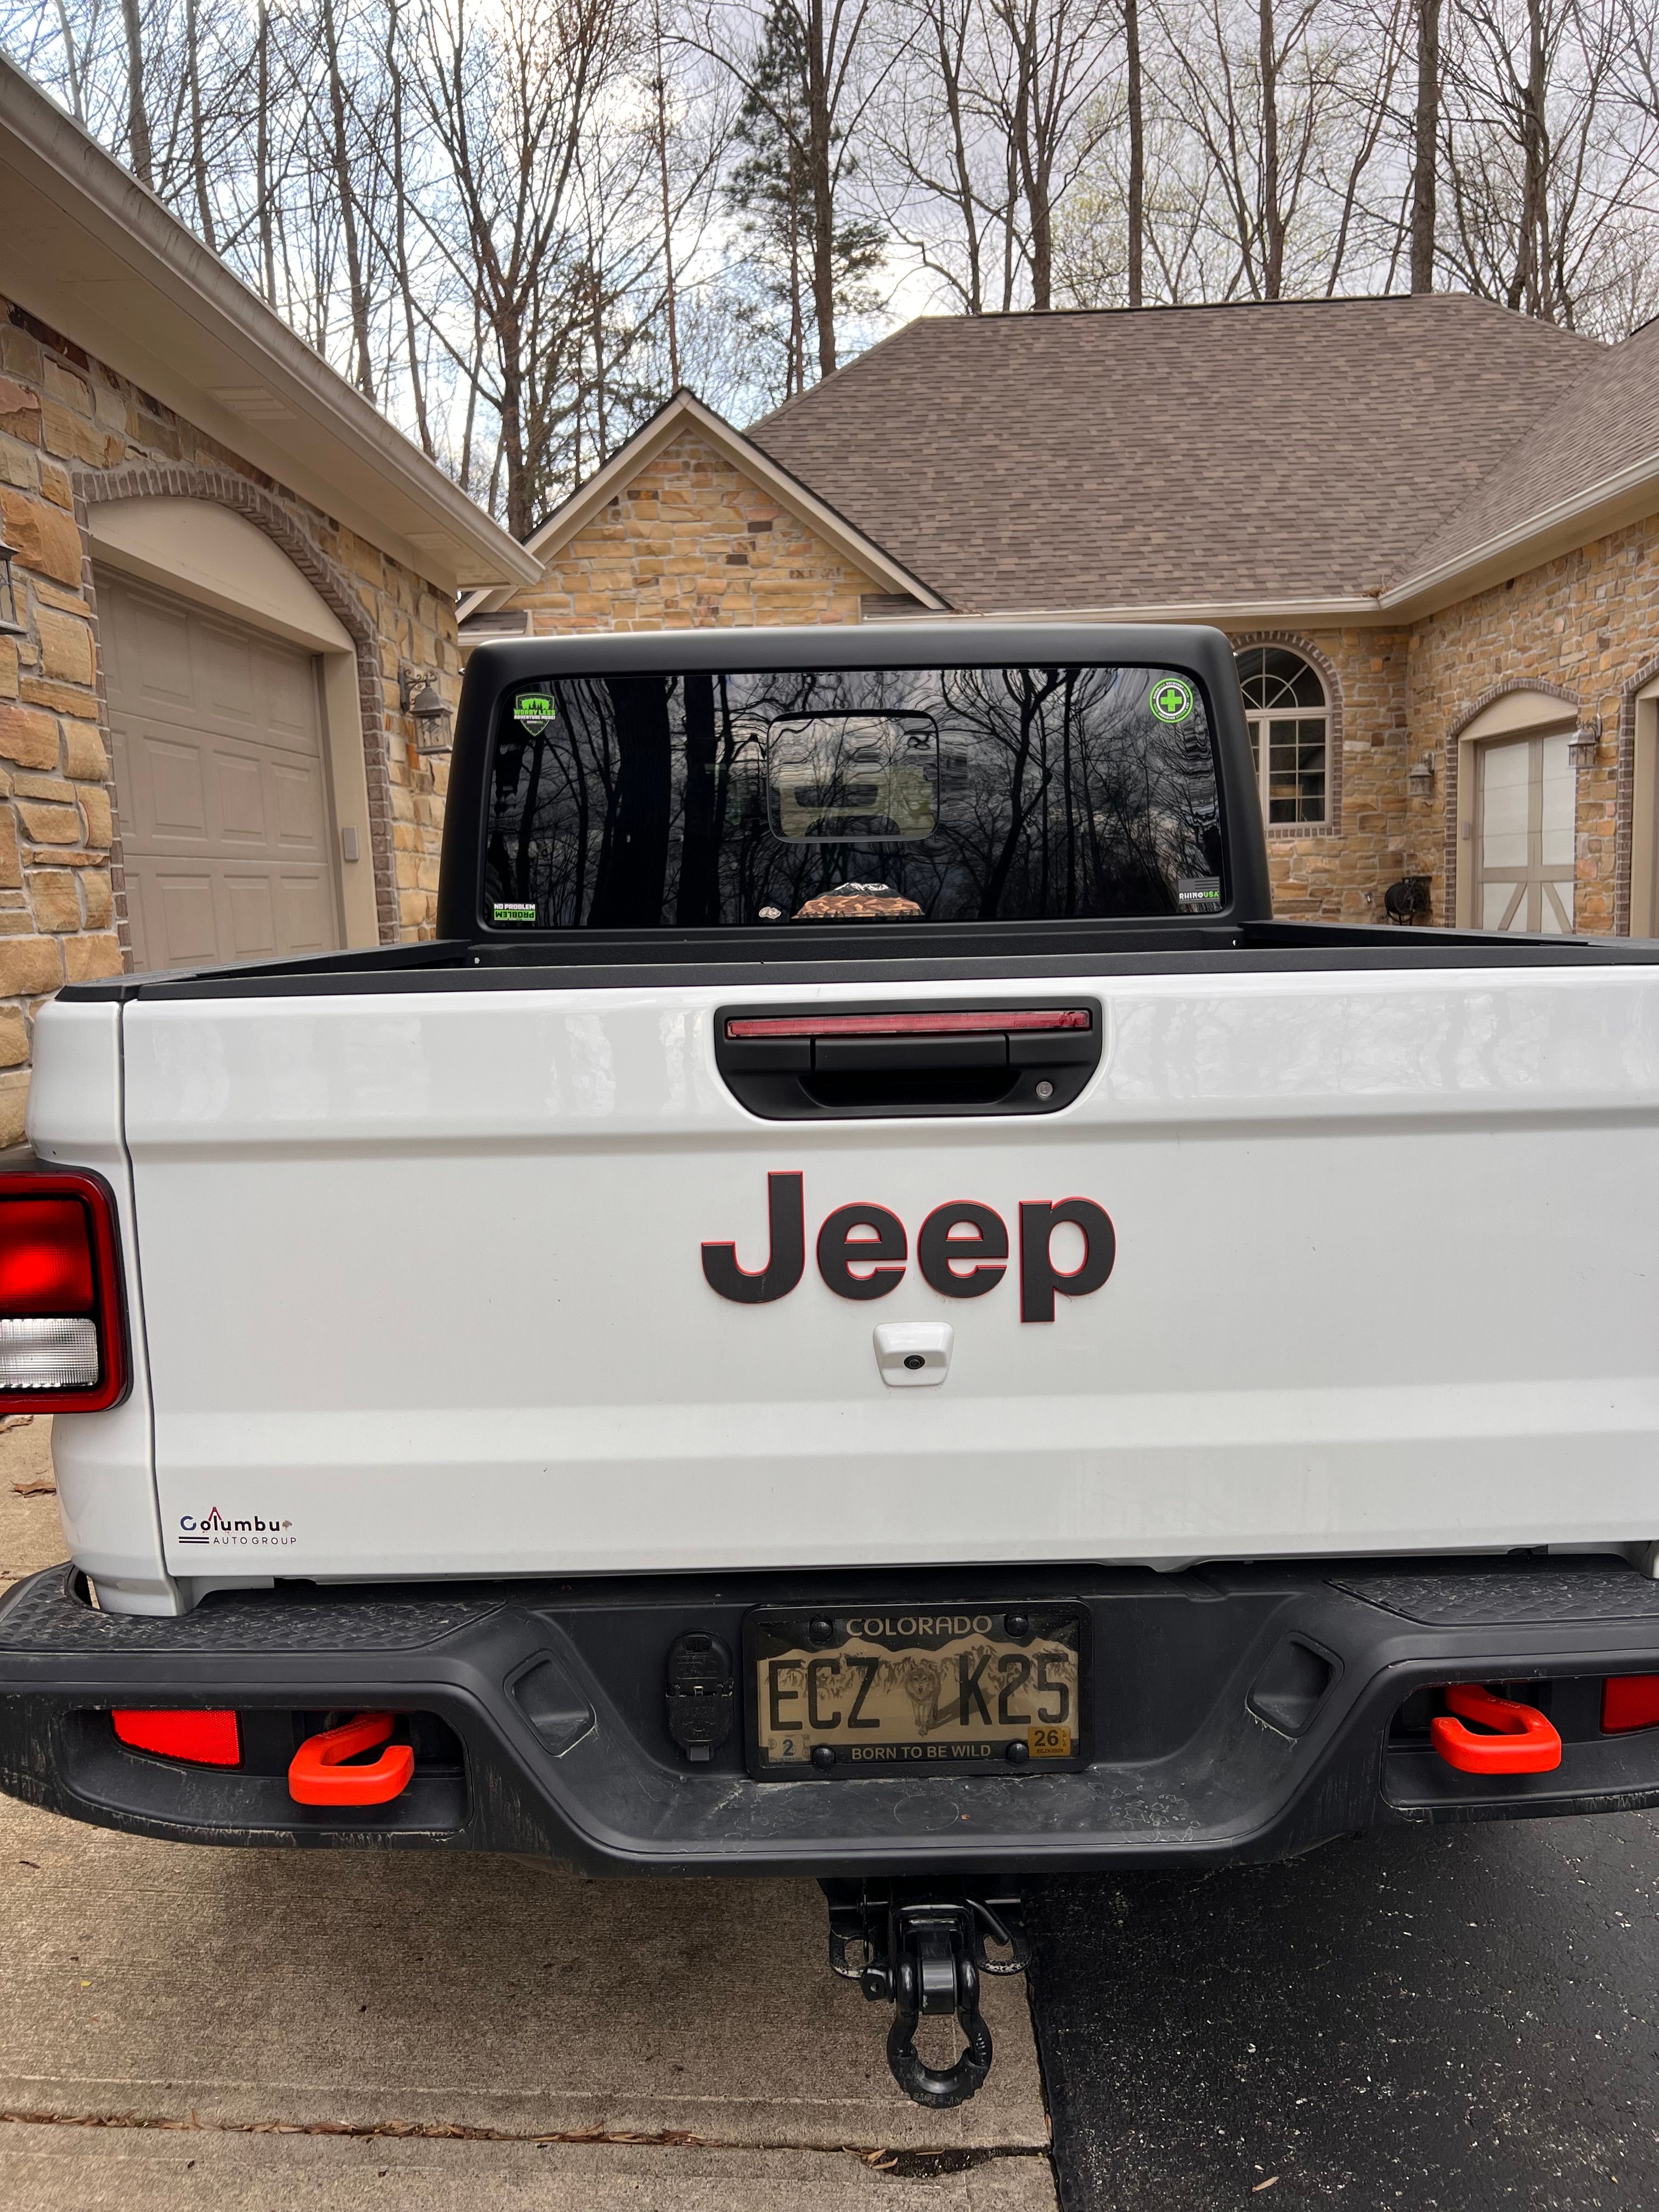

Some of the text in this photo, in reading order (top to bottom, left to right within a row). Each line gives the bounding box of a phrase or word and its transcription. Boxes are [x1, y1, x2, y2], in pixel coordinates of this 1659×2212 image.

[1179, 891, 1220, 900] RHINOUSA
[701, 1170, 1116, 1323] Jeep
[846, 1615, 992, 1637] COLORADO
[768, 1653, 1069, 1731] ECZ K25
[1034, 1730, 1059, 1747] 26
[782, 1739, 794, 1756] 2
[851, 1745, 991, 1760] BORN TO BE WILD
